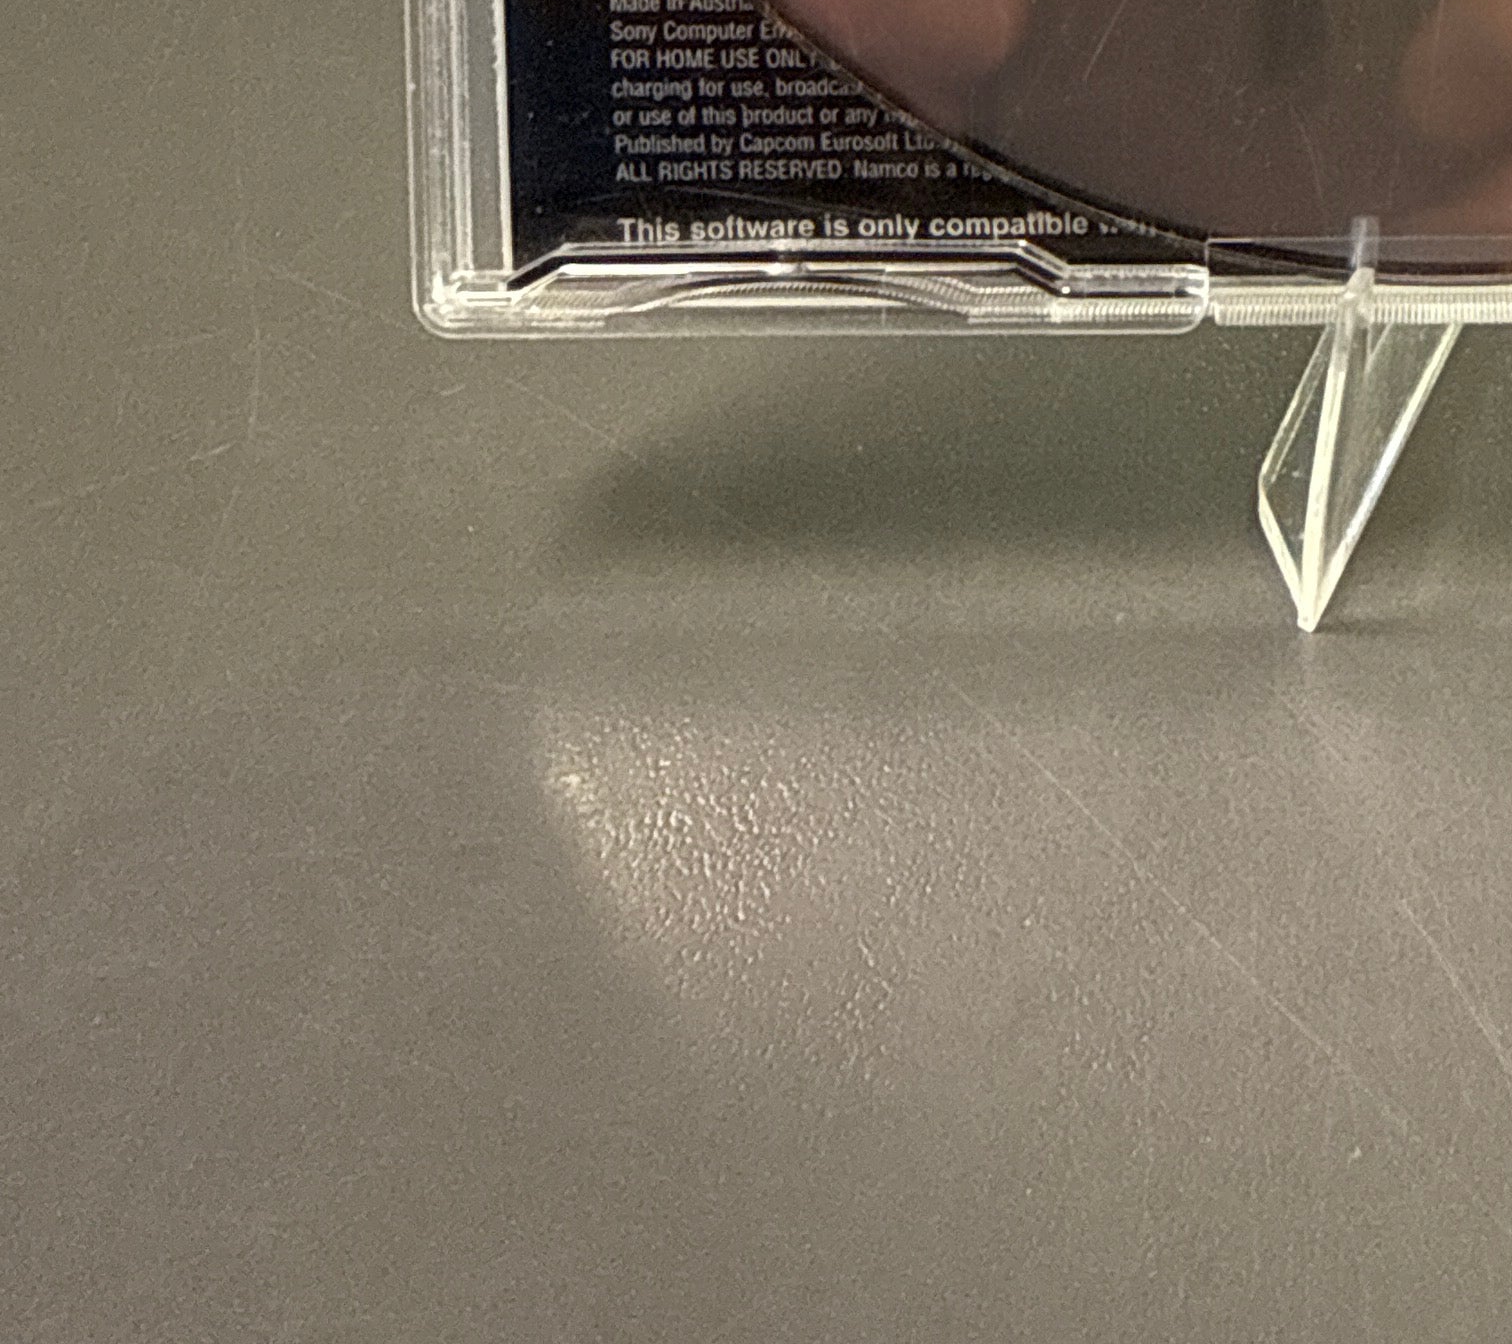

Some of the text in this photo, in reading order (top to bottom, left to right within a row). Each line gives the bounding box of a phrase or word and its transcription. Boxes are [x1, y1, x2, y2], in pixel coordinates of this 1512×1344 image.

[609, 23, 656, 44] Sony
[663, 23, 755, 43] Computer
[610, 52, 649, 69] FOR
[657, 50, 715, 69] HOME
[721, 49, 760, 69] USE
[611, 79, 692, 102] charging
[698, 79, 724, 97] for
[612, 110, 634, 125] or
[639, 110, 672, 126] use
[678, 107, 696, 125] of
[702, 106, 736, 125] this
[743, 105, 813, 128] product
[820, 108, 839, 125] or
[844, 108, 878, 128] any
[614, 136, 706, 156] Published
[711, 137, 733, 156] by
[739, 135, 815, 156] Capcom
[820, 132, 899, 152] Eurosoft
[615, 162, 653, 182] ALL
[658, 161, 732, 181] RIGHTS
[854, 159, 918, 180] Namco
[924, 160, 941, 178] is
[945, 162, 957, 179] a
[616, 216, 680, 242] This
[689, 214, 816, 241] software
[823, 213, 850, 237] is
[858, 213, 919, 240] only
[929, 211, 1090, 241] compatible
